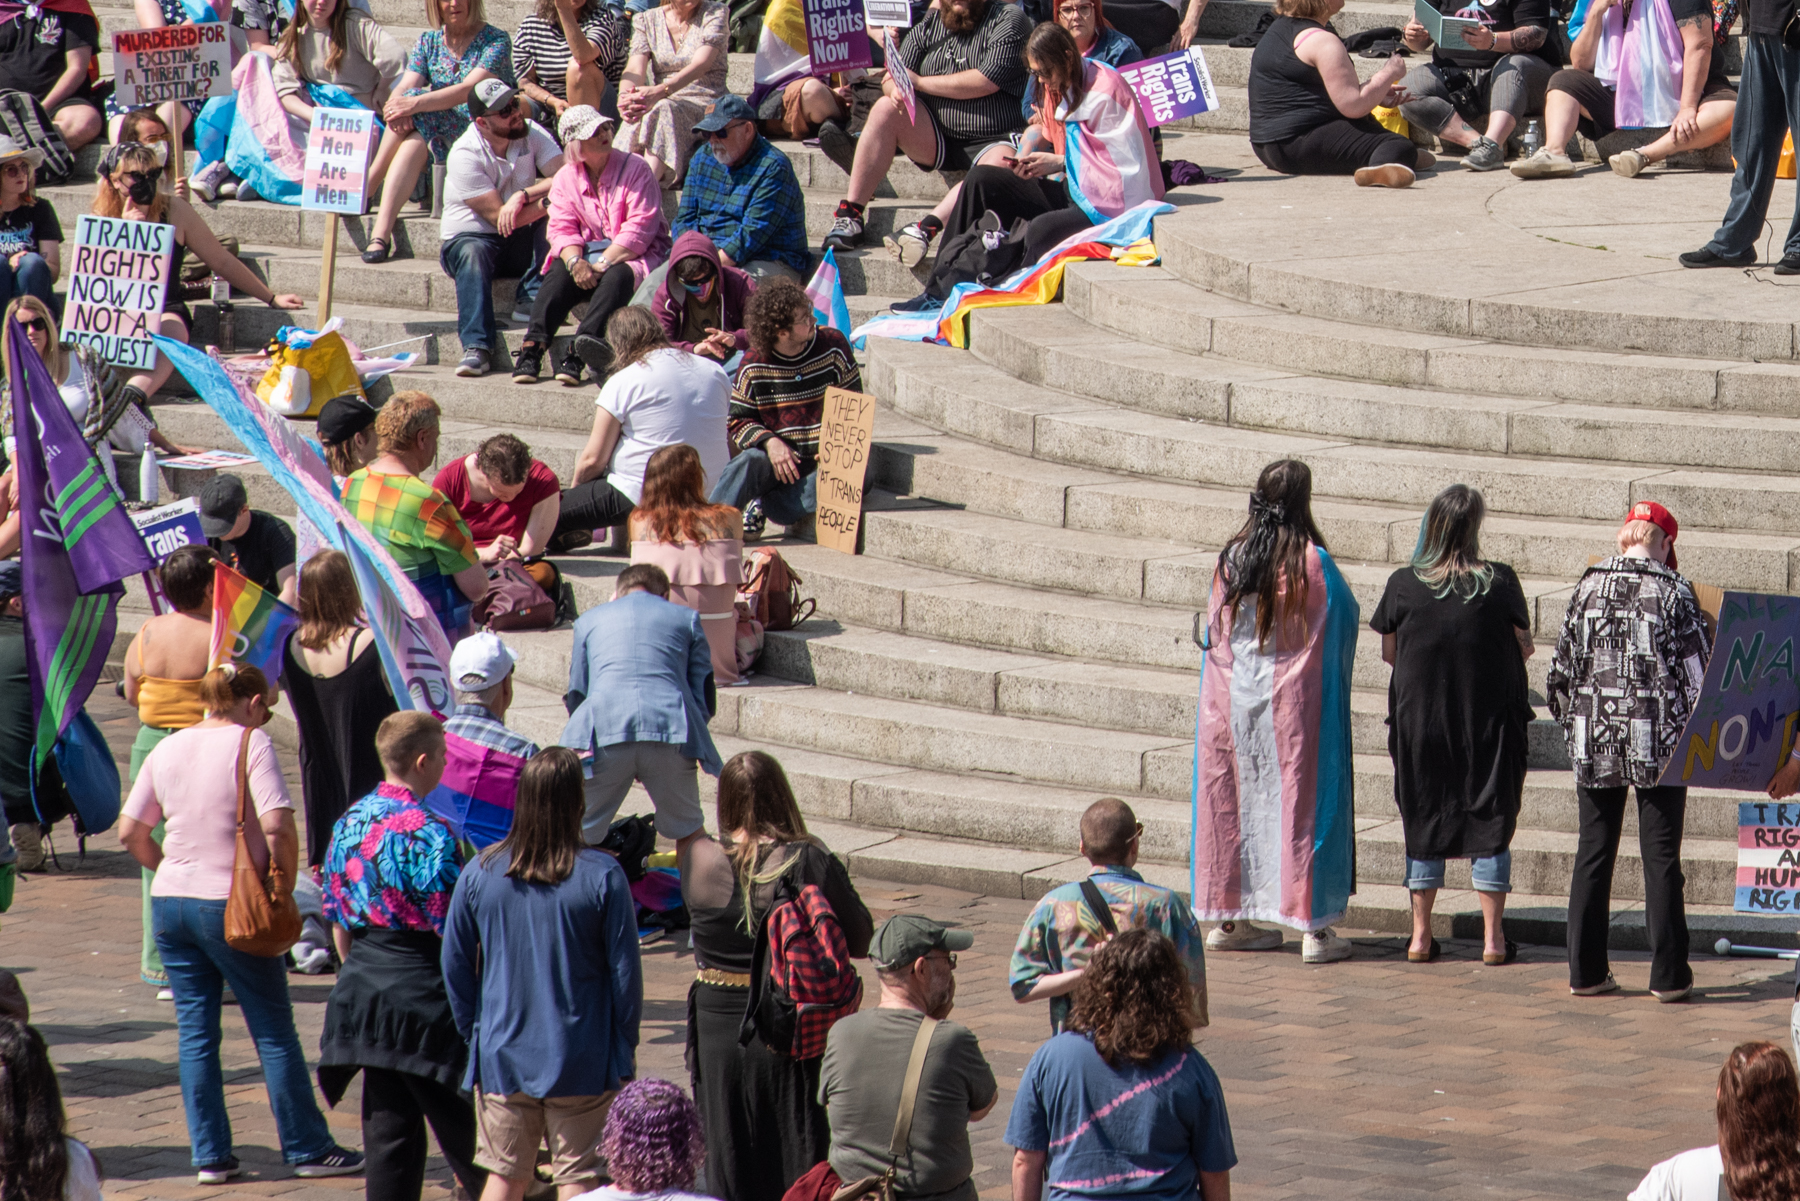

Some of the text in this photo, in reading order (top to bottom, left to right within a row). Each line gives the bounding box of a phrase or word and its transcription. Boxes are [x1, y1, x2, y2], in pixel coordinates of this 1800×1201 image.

[116, 25, 226, 53] MURDERED FOR
[809, 9, 864, 41] Rights
[136, 47, 200, 69] EXISTING
[813, 40, 849, 65] Now
[124, 60, 220, 85] A THREAT FOR
[1166, 51, 1197, 104] Trans
[135, 78, 212, 104] RESISTING?
[1140, 62, 1176, 122] Rights
[320, 113, 362, 134] Trans
[320, 136, 353, 156] Men
[319, 162, 347, 180] Are
[315, 183, 348, 205] Men
[84, 218, 165, 252] TRANS
[76, 247, 162, 281] RIGHTS
[71, 275, 159, 311] NOW IS
[74, 304, 148, 339] NOT A
[832, 394, 870, 423] THEY
[825, 418, 866, 448] NEVER
[823, 441, 863, 470] STOP
[820, 469, 862, 504] AT TRANS
[137, 507, 183, 528] Socialist Worker
[818, 506, 857, 534] PEOPLE
[141, 525, 190, 558] rans
